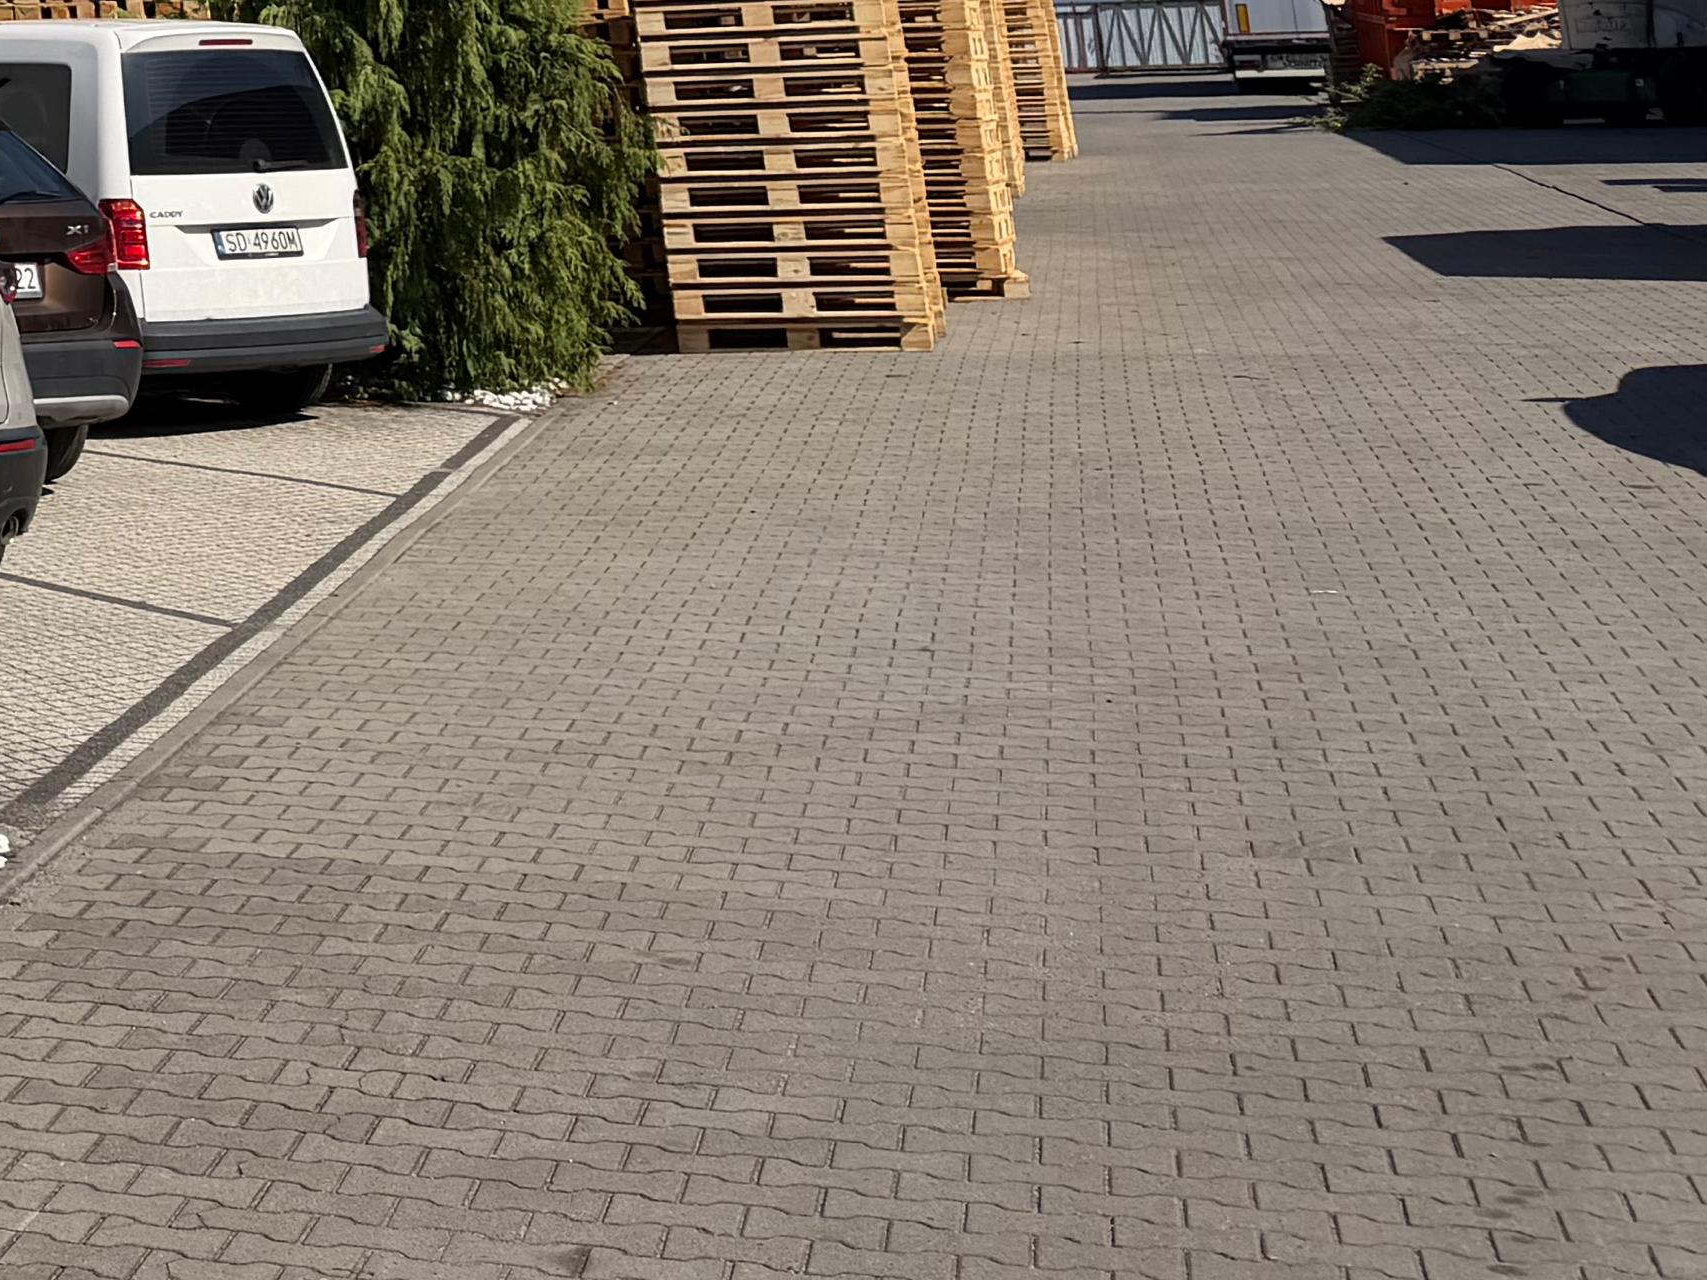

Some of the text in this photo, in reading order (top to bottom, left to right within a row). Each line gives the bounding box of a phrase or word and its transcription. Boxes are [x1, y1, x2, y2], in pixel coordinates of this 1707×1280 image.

[149, 210, 184, 219] CADDY
[225, 230, 299, 252] SD 4960M
